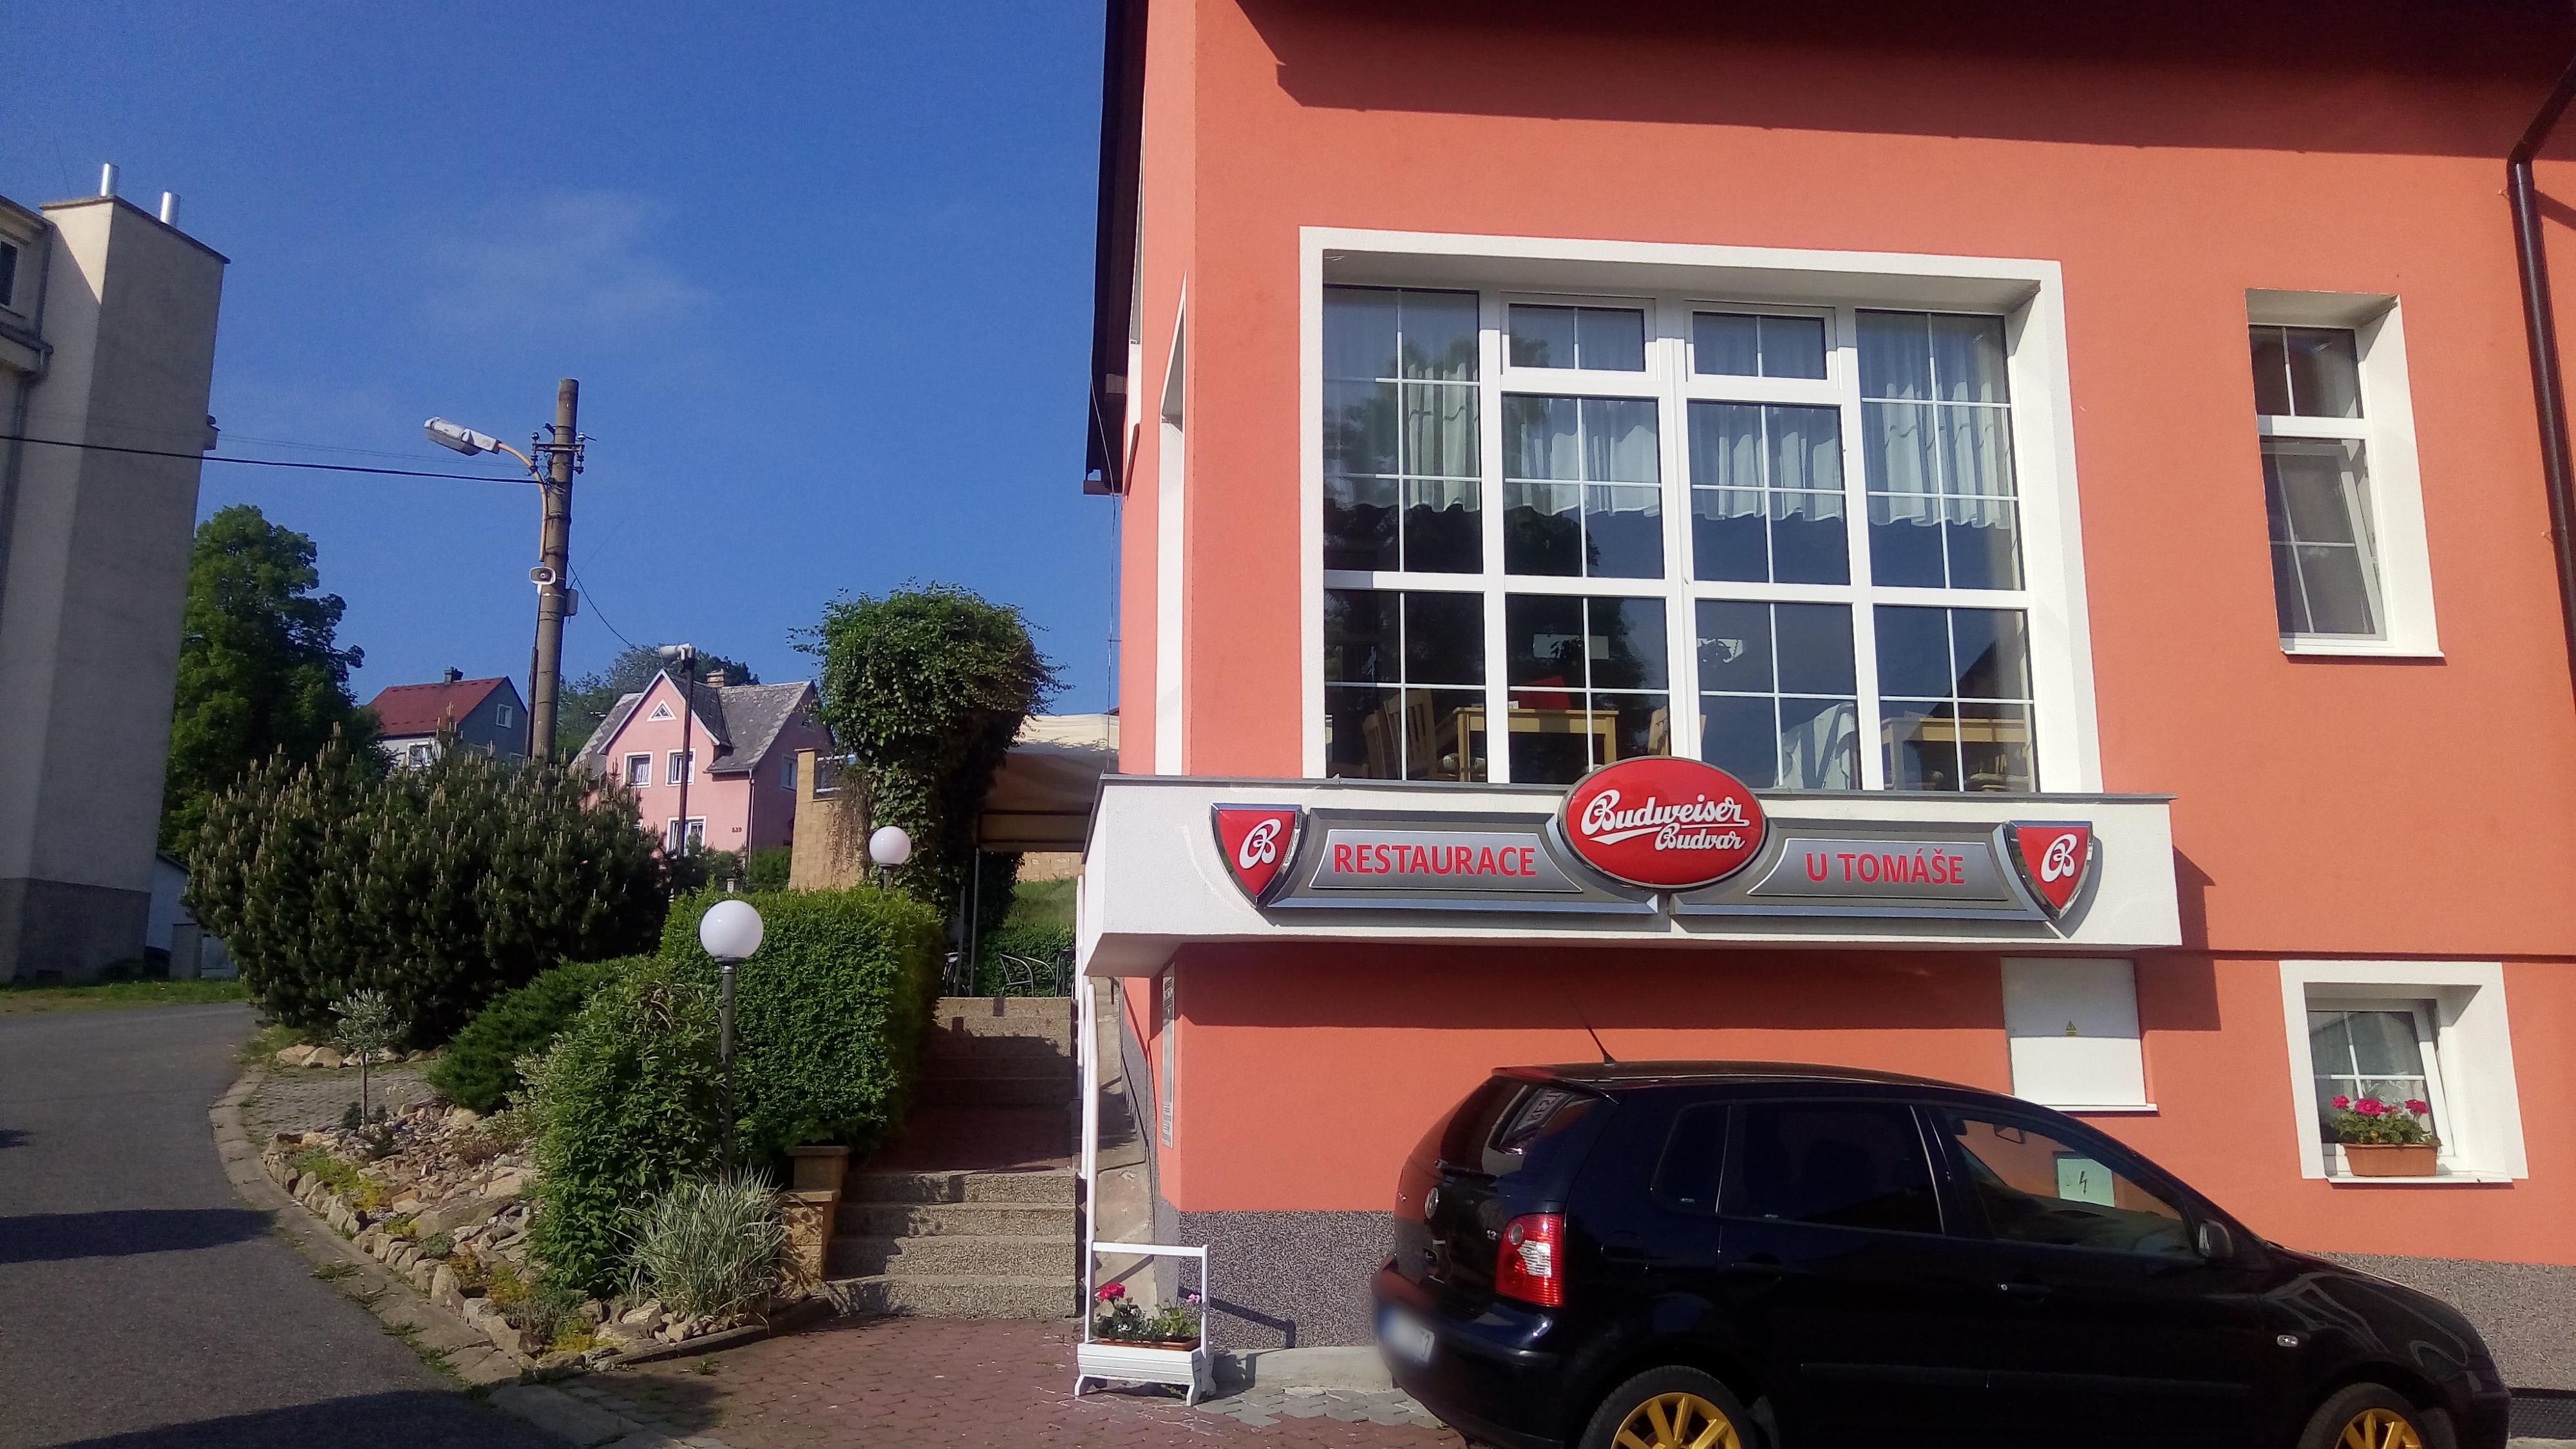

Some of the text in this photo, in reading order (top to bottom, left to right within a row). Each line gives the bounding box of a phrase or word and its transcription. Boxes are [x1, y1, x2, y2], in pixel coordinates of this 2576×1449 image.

[1580, 789, 1750, 835] Budweiser
[1654, 822, 1745, 851] Budvar
[1334, 844, 1537, 876] RESTAURACE
[1806, 848, 1965, 885] U TOMÁŠE
